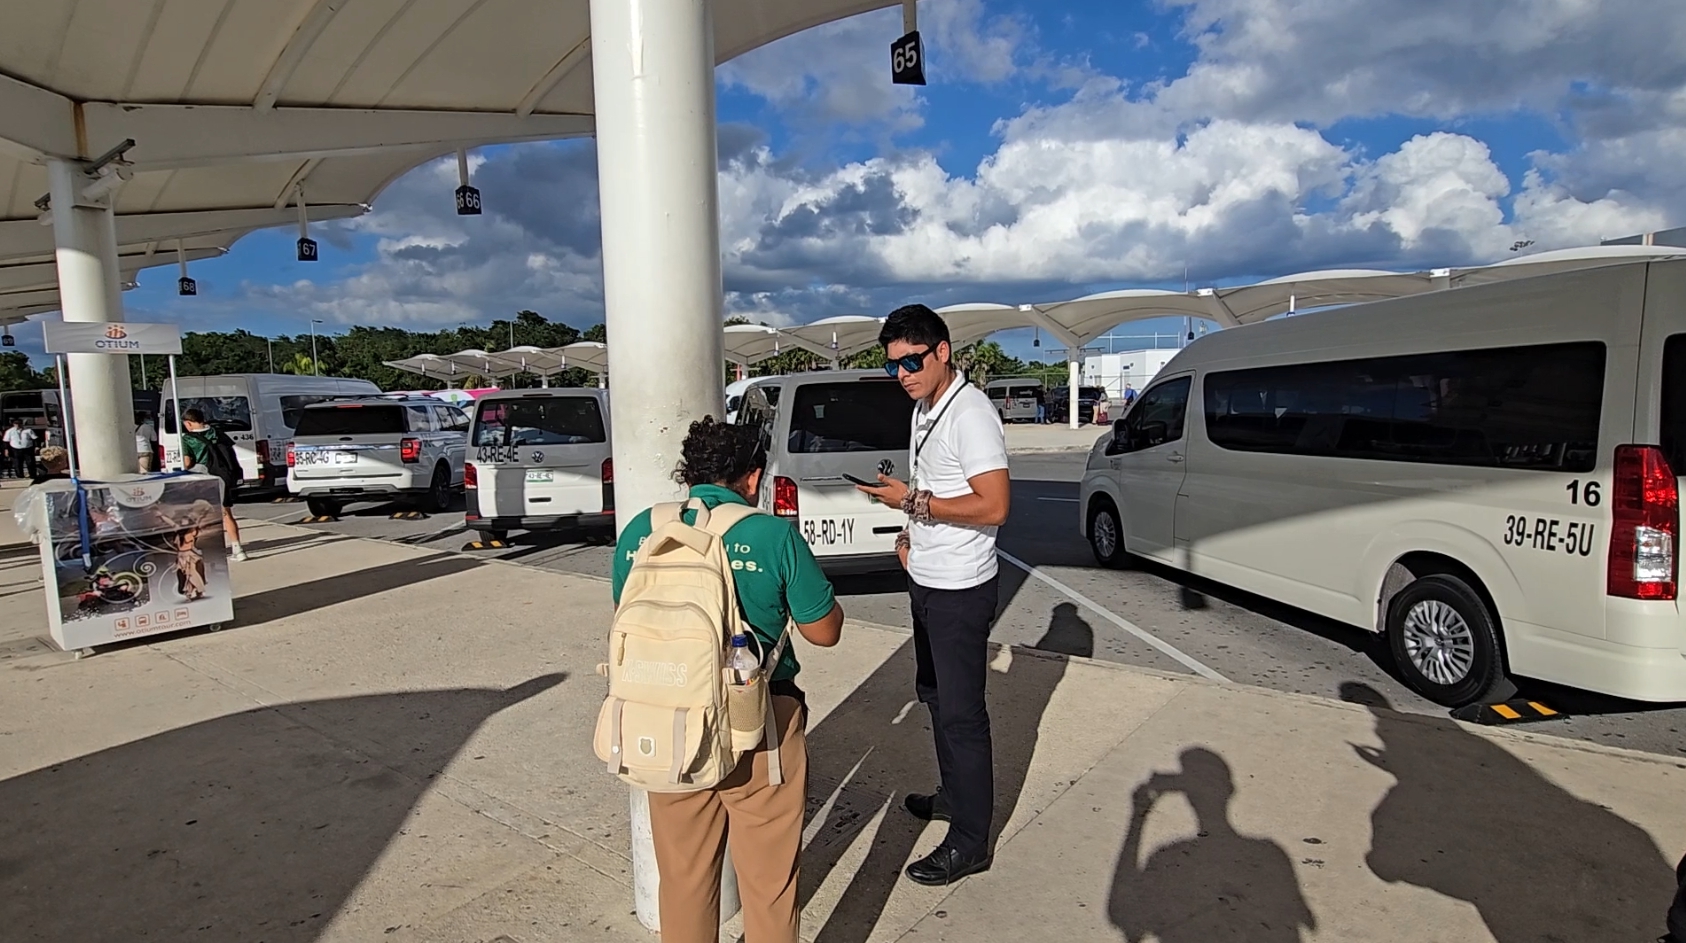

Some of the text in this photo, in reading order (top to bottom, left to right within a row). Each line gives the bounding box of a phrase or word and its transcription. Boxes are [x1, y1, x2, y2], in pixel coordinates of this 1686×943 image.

[893, 41, 917, 73] 65
[465, 191, 480, 210] 66
[302, 243, 316, 256] 67
[183, 281, 195, 292] 68
[95, 339, 140, 349] OTIUM
[476, 445, 519, 463] 43-RE-4E
[1566, 479, 1601, 507] 16
[803, 518, 855, 546] 58-RD-1Y
[1503, 515, 1595, 557] 39-RE-5U
[734, 542, 751, 554] to
